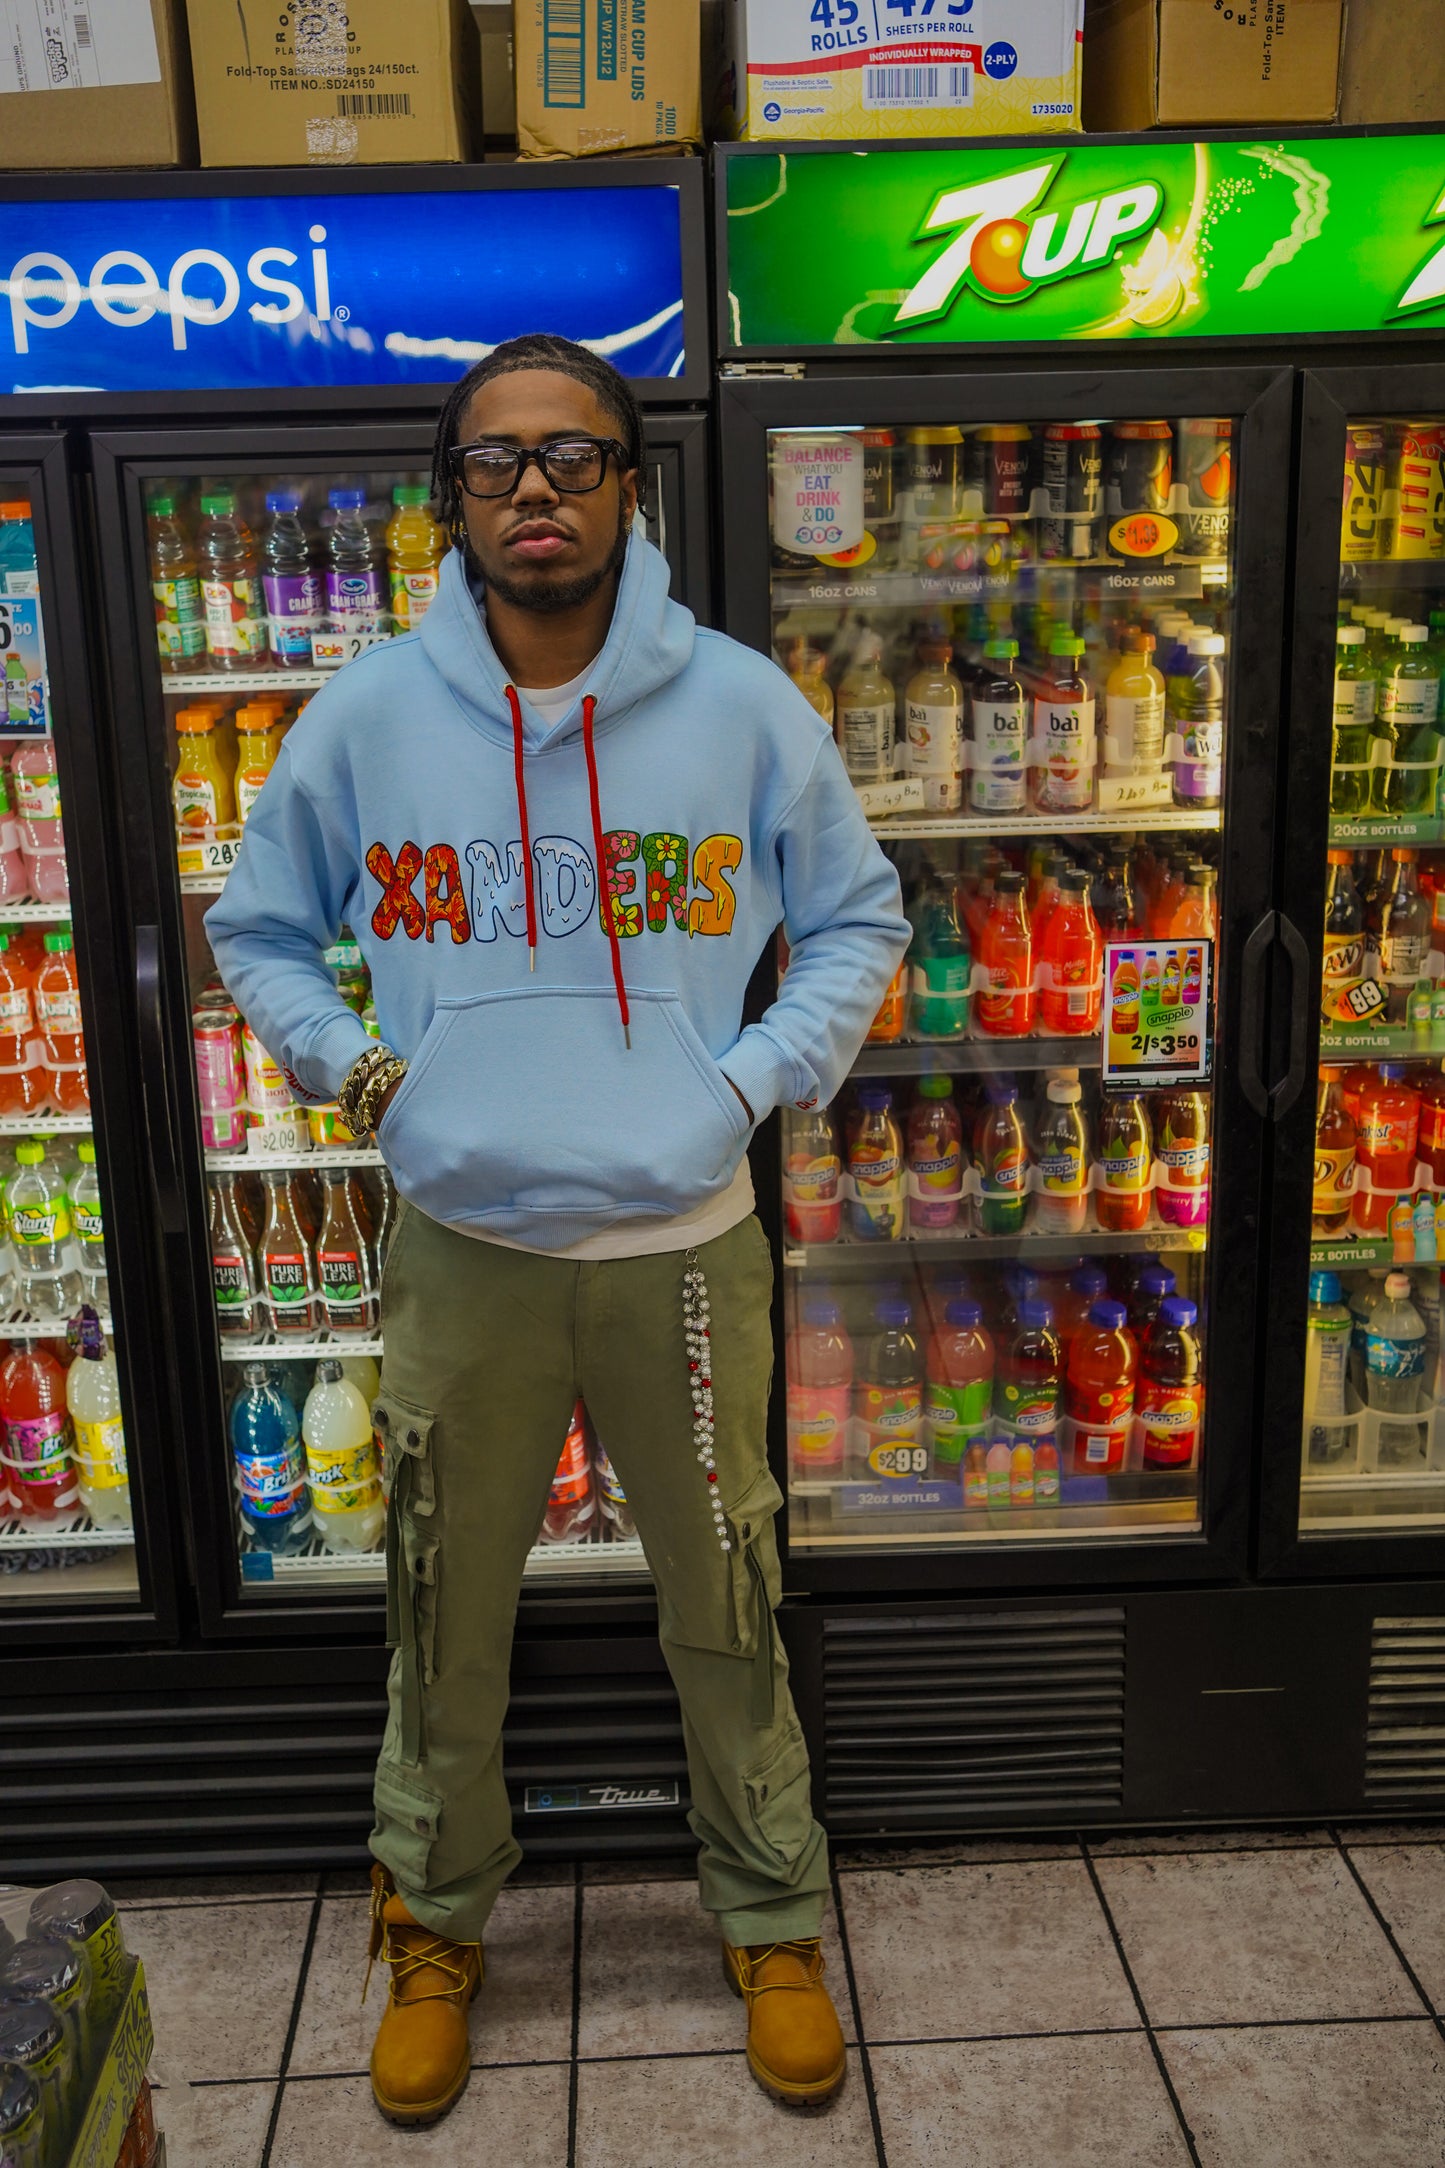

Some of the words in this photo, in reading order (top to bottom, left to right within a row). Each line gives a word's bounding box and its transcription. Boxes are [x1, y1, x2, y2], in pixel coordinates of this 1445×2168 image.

[810, 0, 859, 29] 45
[1275, 4, 1286, 35] ITEM
[886, 24, 925, 37] SHEETS
[927, 23, 947, 34] PER
[948, 22, 974, 34] ROLL
[631, 28, 646, 61] CUP
[811, 26, 868, 51] ROLLS
[54, 40, 68, 65] you
[601, 20, 613, 75] W12J12
[619, 33, 628, 73] SLOTTED
[869, 48, 930, 62] INDIVIDUALLY
[930, 49, 972, 60] WRAPPED
[1262, 26, 1275, 81] Fold-Top
[13, 45, 24, 75] GROUND
[46, 38, 62, 83] snacks
[986, 54, 1016, 67] 2-PLY
[226, 65, 277, 78] Fold-Top
[368, 64, 420, 75] 24/150ct.
[270, 80, 298, 90] ITEM
[631, 66, 645, 102] LIDS
[1032, 104, 1074, 115] 1735020
[655, 111, 663, 137] PKGS.
[665, 106, 677, 135] 1000
[8, 224, 331, 354] pepsi
[784, 447, 853, 463] BALANCE
[794, 464, 821, 475] WHAT
[824, 463, 843, 474] YOU
[804, 475, 832, 490] EAT
[796, 492, 841, 507] DRINK
[802, 507, 813, 522] &
[815, 507, 835, 522] DO
[410, 578, 433, 589] Dole
[1107, 575, 1140, 588] 16oz
[1142, 575, 1176, 587] CANS
[808, 585, 842, 598] 16oz
[844, 586, 878, 597] CANS
[315, 643, 344, 656] Dole
[909, 706, 928, 721] bai
[1050, 709, 1080, 732] bai
[1334, 824, 1368, 837] 20oz
[1370, 824, 1418, 836] BOTTLES
[365, 829, 744, 945] XANDERS
[1150, 1008, 1191, 1024] snapple
[1345, 1035, 1391, 1047] BOTTLES
[263, 1130, 295, 1149] $2.09
[11, 1210, 56, 1237] Starry
[1327, 1248, 1377, 1261] BOTTLES
[214, 1265, 242, 1277] PURE
[270, 1264, 301, 1276] PURE
[323, 1262, 354, 1274] PURE
[271, 1273, 304, 1284] LEAF
[324, 1270, 357, 1282] LEAF
[1143, 1410, 1192, 1426] snapple
[858, 1493, 889, 1506] 32oz
[891, 1492, 941, 1504] BOTTLES
